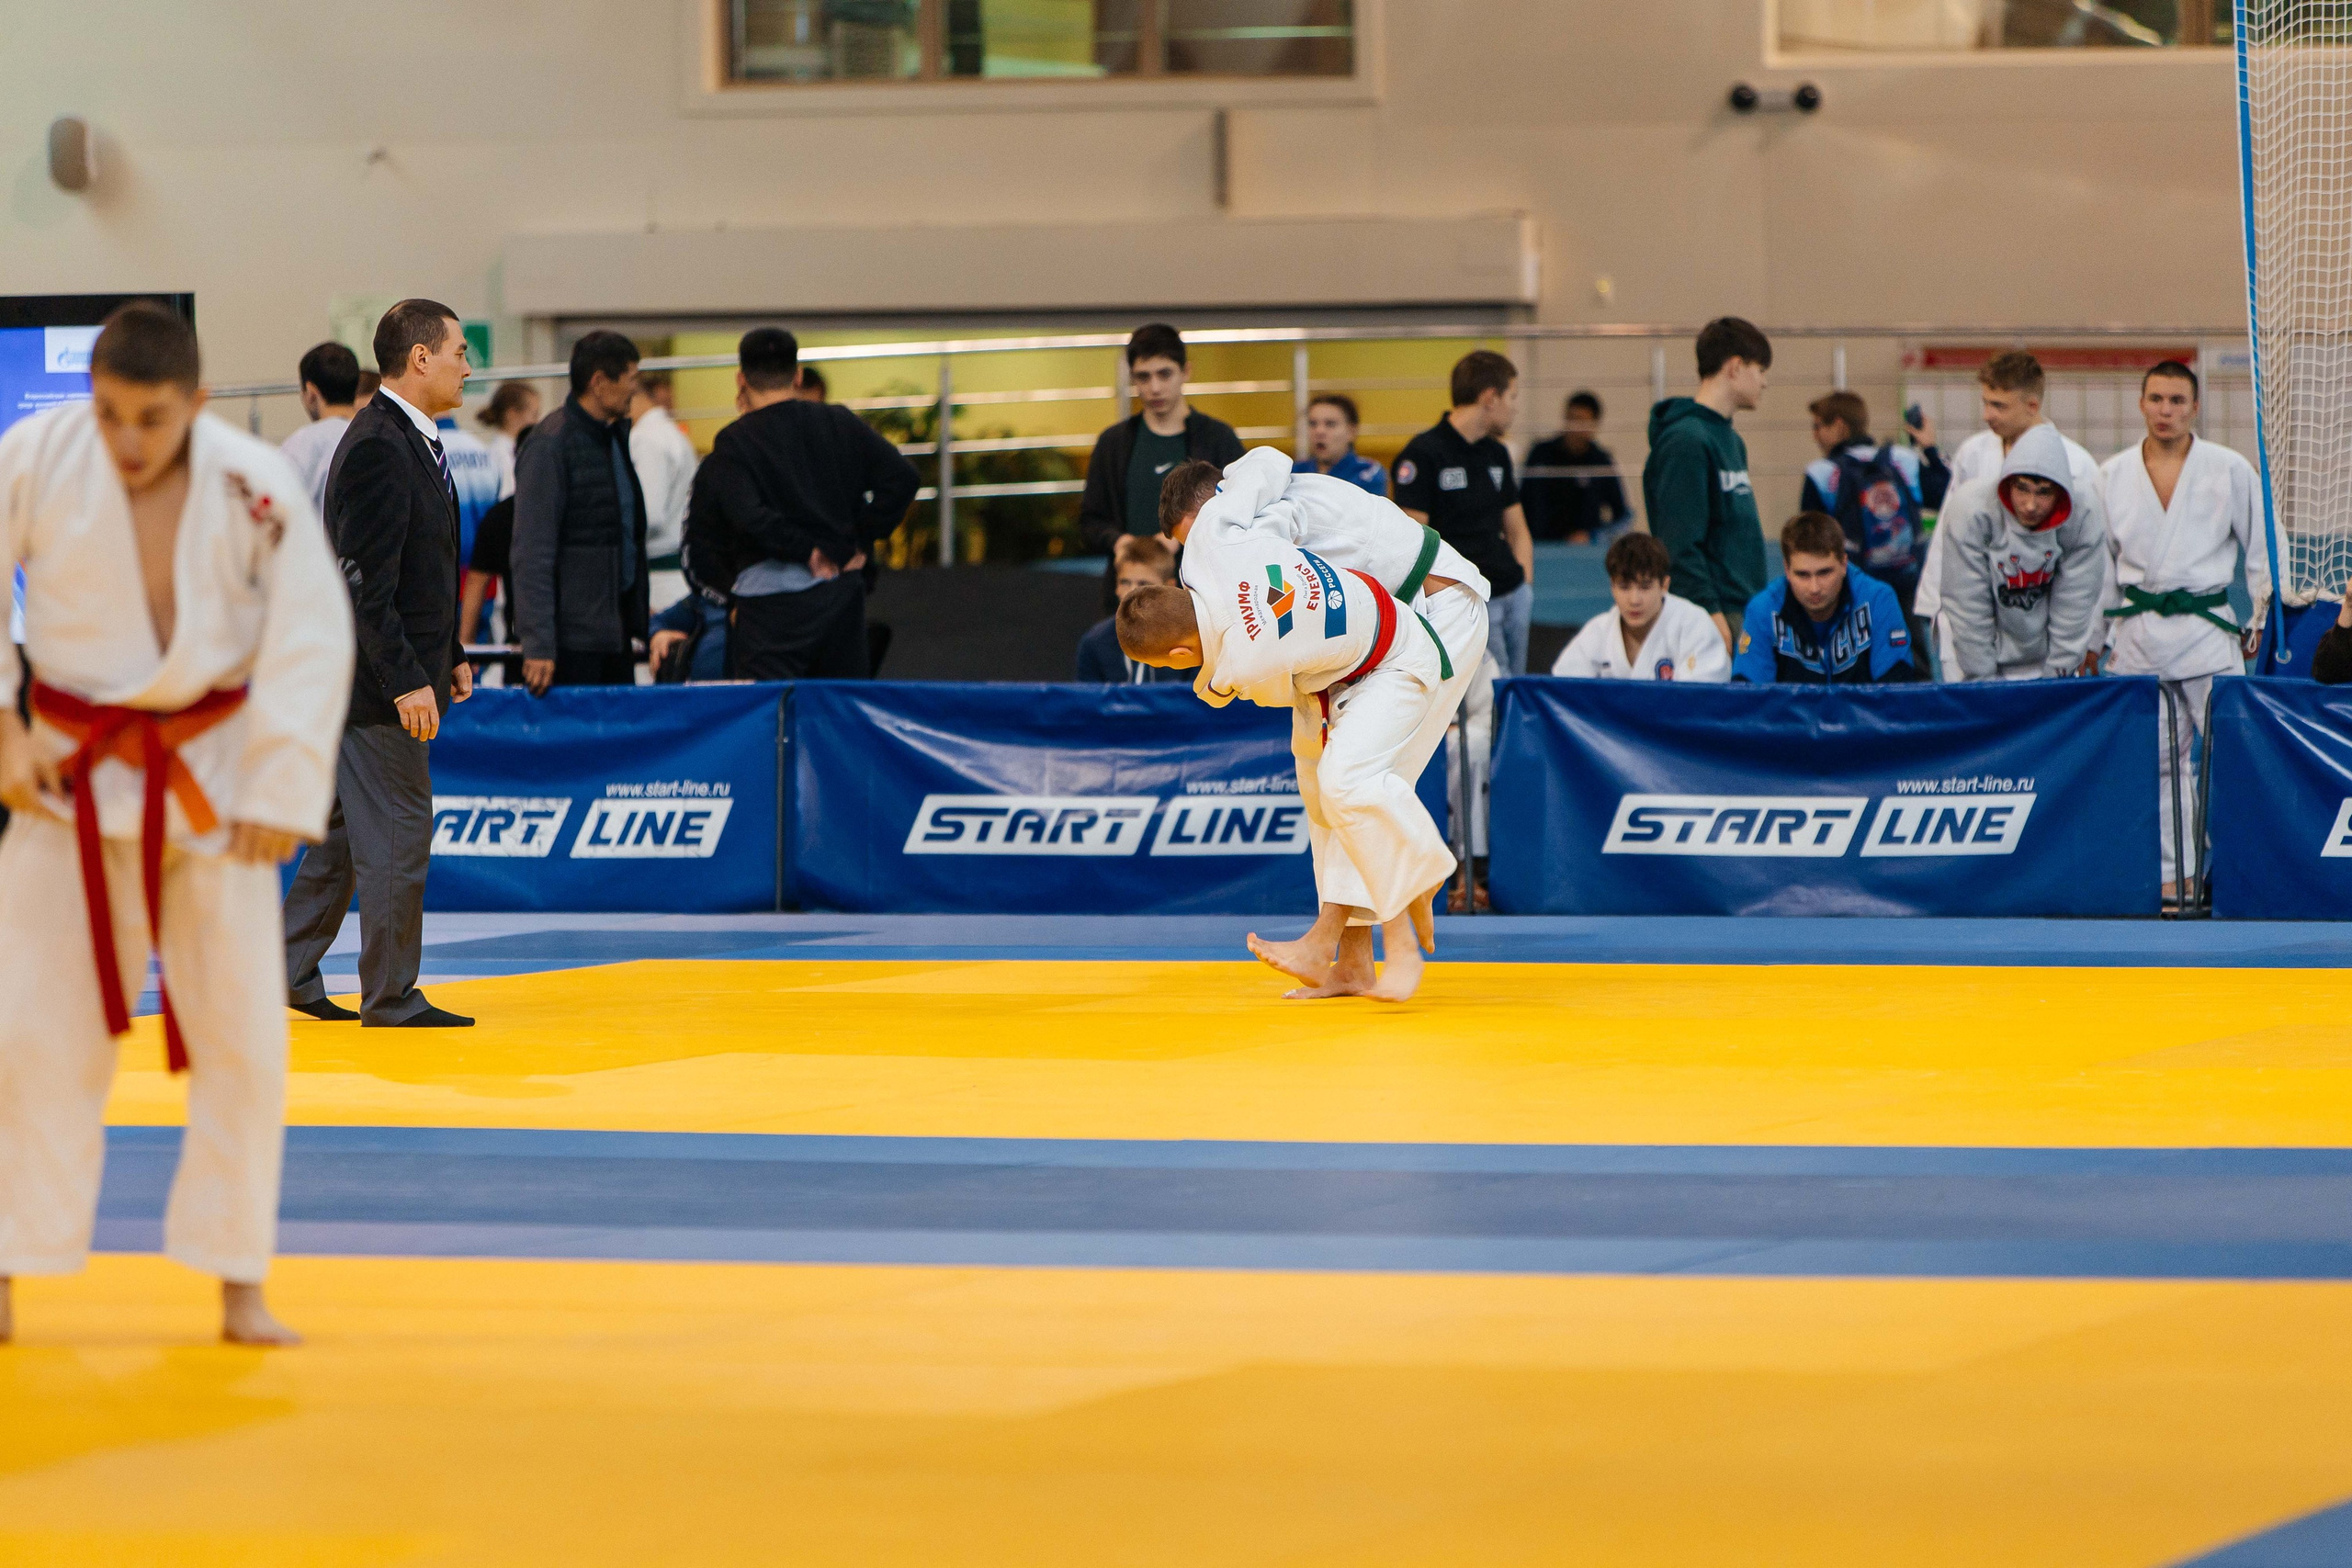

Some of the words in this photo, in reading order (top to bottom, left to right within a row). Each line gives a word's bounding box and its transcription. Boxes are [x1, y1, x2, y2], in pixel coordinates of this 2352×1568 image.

[1294, 563, 1321, 612] ENERGY
[1313, 559, 1336, 589] РОССЕТИ
[1238, 581, 1262, 642] ТРИУМФ
[606, 779, 731, 797] www.start-line.ru
[1186, 774, 1299, 795] www.start-line
[1896, 775, 2035, 795] www.start-line.ru
[433, 809, 557, 844] ART
[586, 810, 712, 846] LINE
[922, 807, 1143, 844] START
[1168, 807, 1305, 844] LINE
[1621, 807, 1852, 845] START
[1878, 807, 2016, 845] LINE
